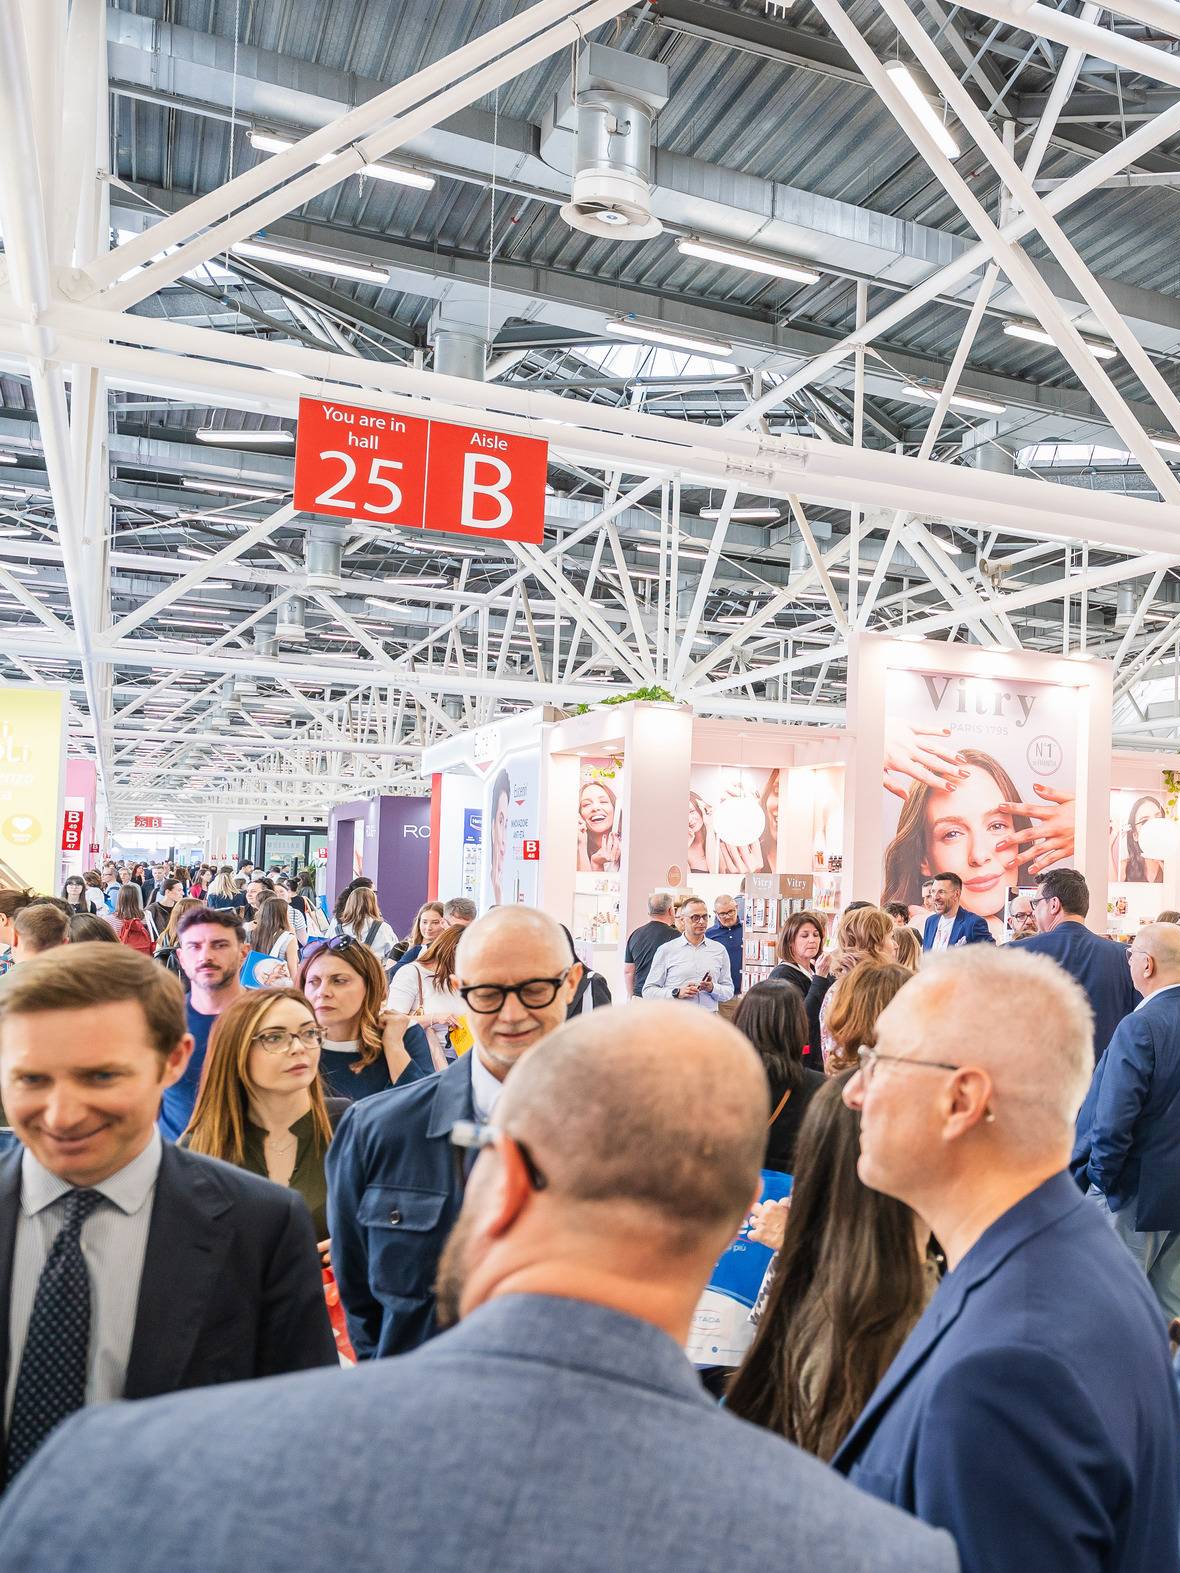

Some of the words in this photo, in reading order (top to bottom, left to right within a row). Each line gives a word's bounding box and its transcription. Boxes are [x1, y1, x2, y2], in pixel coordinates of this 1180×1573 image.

[321, 405, 354, 424] You
[359, 414, 386, 430] are
[390, 418, 406, 433] in
[348, 431, 379, 450] hall
[469, 432, 508, 451] Aisle
[314, 450, 403, 515] 25
[460, 452, 513, 530] B
[921, 674, 1037, 727] Vitry
[950, 722, 983, 734] PARIS
[985, 725, 1009, 736] 1795
[68, 811, 80, 823] B
[152, 819, 159, 827] B
[66, 830, 78, 843] B
[526, 841, 537, 852] B
[786, 877, 807, 890] Vitry
